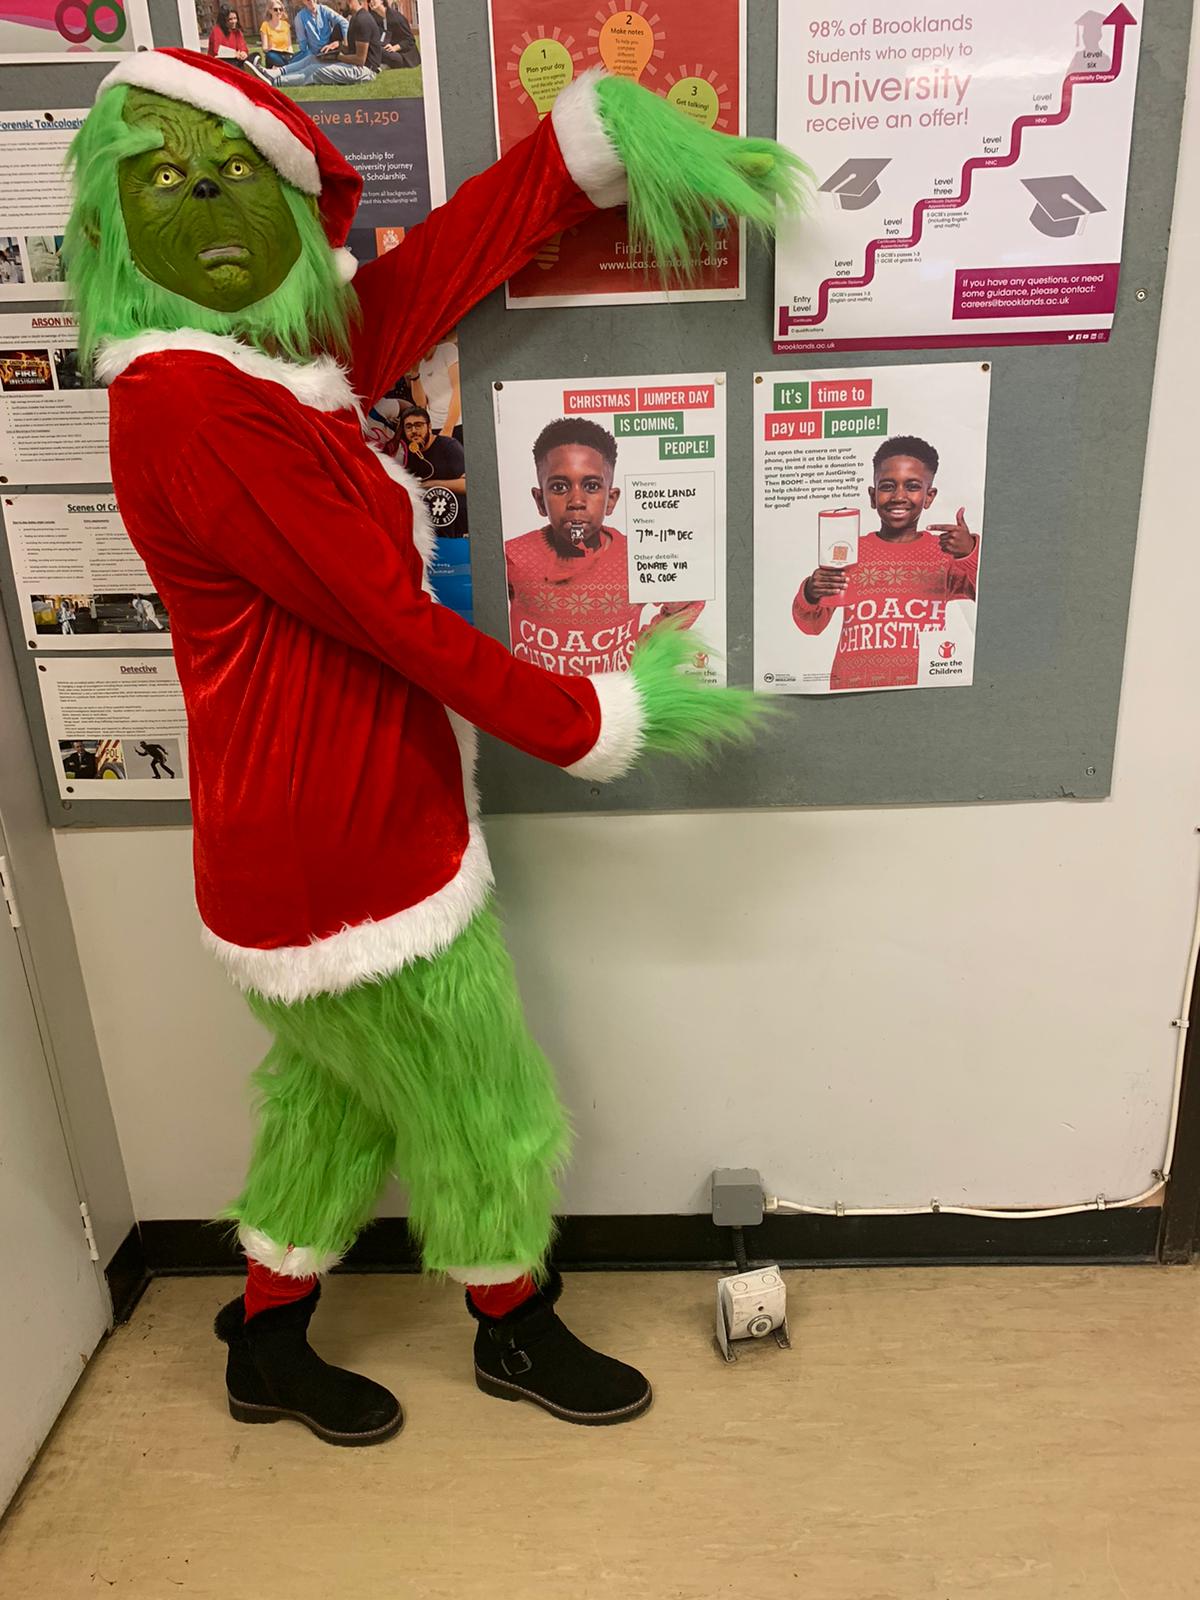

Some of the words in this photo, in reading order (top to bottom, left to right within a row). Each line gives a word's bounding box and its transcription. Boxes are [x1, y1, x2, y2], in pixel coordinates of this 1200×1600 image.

[626, 15, 632, 25] 2
[809, 20, 845, 38] 98%
[850, 19, 867, 36] of
[873, 14, 973, 34] Brooklands
[541, 49, 546, 59] 1
[807, 48, 870, 64] Students
[876, 46, 906, 60] who
[912, 44, 954, 61] apply
[959, 43, 973, 56] to
[1083, 50, 1102, 58] Level
[554, 62, 565, 70] day
[691, 86, 697, 96] 3
[808, 68, 971, 106] University
[1033, 93, 1052, 101] Level
[344, 113, 352, 123] a
[356, 109, 399, 126] £1,250
[807, 113, 879, 132] receive
[886, 114, 911, 128] an
[920, 107, 968, 126] offer!
[983, 136, 1002, 144] Level
[345, 152, 383, 160] scholarship
[353, 163, 386, 171] university
[387, 163, 413, 171] journey
[367, 172, 407, 181] Scholarship.
[963, 279, 968, 287] If
[1010, 279, 1025, 287] any
[1028, 276, 1069, 285] questions,
[1082, 274, 1104, 282] need
[962, 290, 985, 298] some
[987, 287, 1029, 298] guidance,
[1031, 286, 1058, 296] please
[1061, 285, 1096, 294] contact:
[32, 318, 61, 326] ARSON
[778, 342, 835, 350] brooklands.ac.uk
[570, 394, 630, 409] CHRISTMAS
[643, 392, 685, 406] JUMPER
[689, 390, 709, 404] DAY
[782, 389, 802, 404] It's
[818, 388, 847, 402] time
[852, 387, 864, 401] to
[620, 420, 630, 432] IS
[634, 417, 678, 432] COMING,
[772, 422, 795, 437] pay
[800, 421, 815, 436] up
[831, 415, 880, 435] people!
[665, 440, 709, 455] PEOPLE!
[68, 504, 94, 512] Scenes
[96, 503, 106, 511] Of
[641, 500, 680, 510] COLLEGE
[677, 530, 693, 540] DEC
[637, 561, 668, 571] DONATE
[673, 561, 687, 570] VIA
[640, 573, 655, 583] QR
[658, 573, 677, 582] CODE
[520, 618, 635, 652] COACH
[120, 665, 157, 673] Detective
